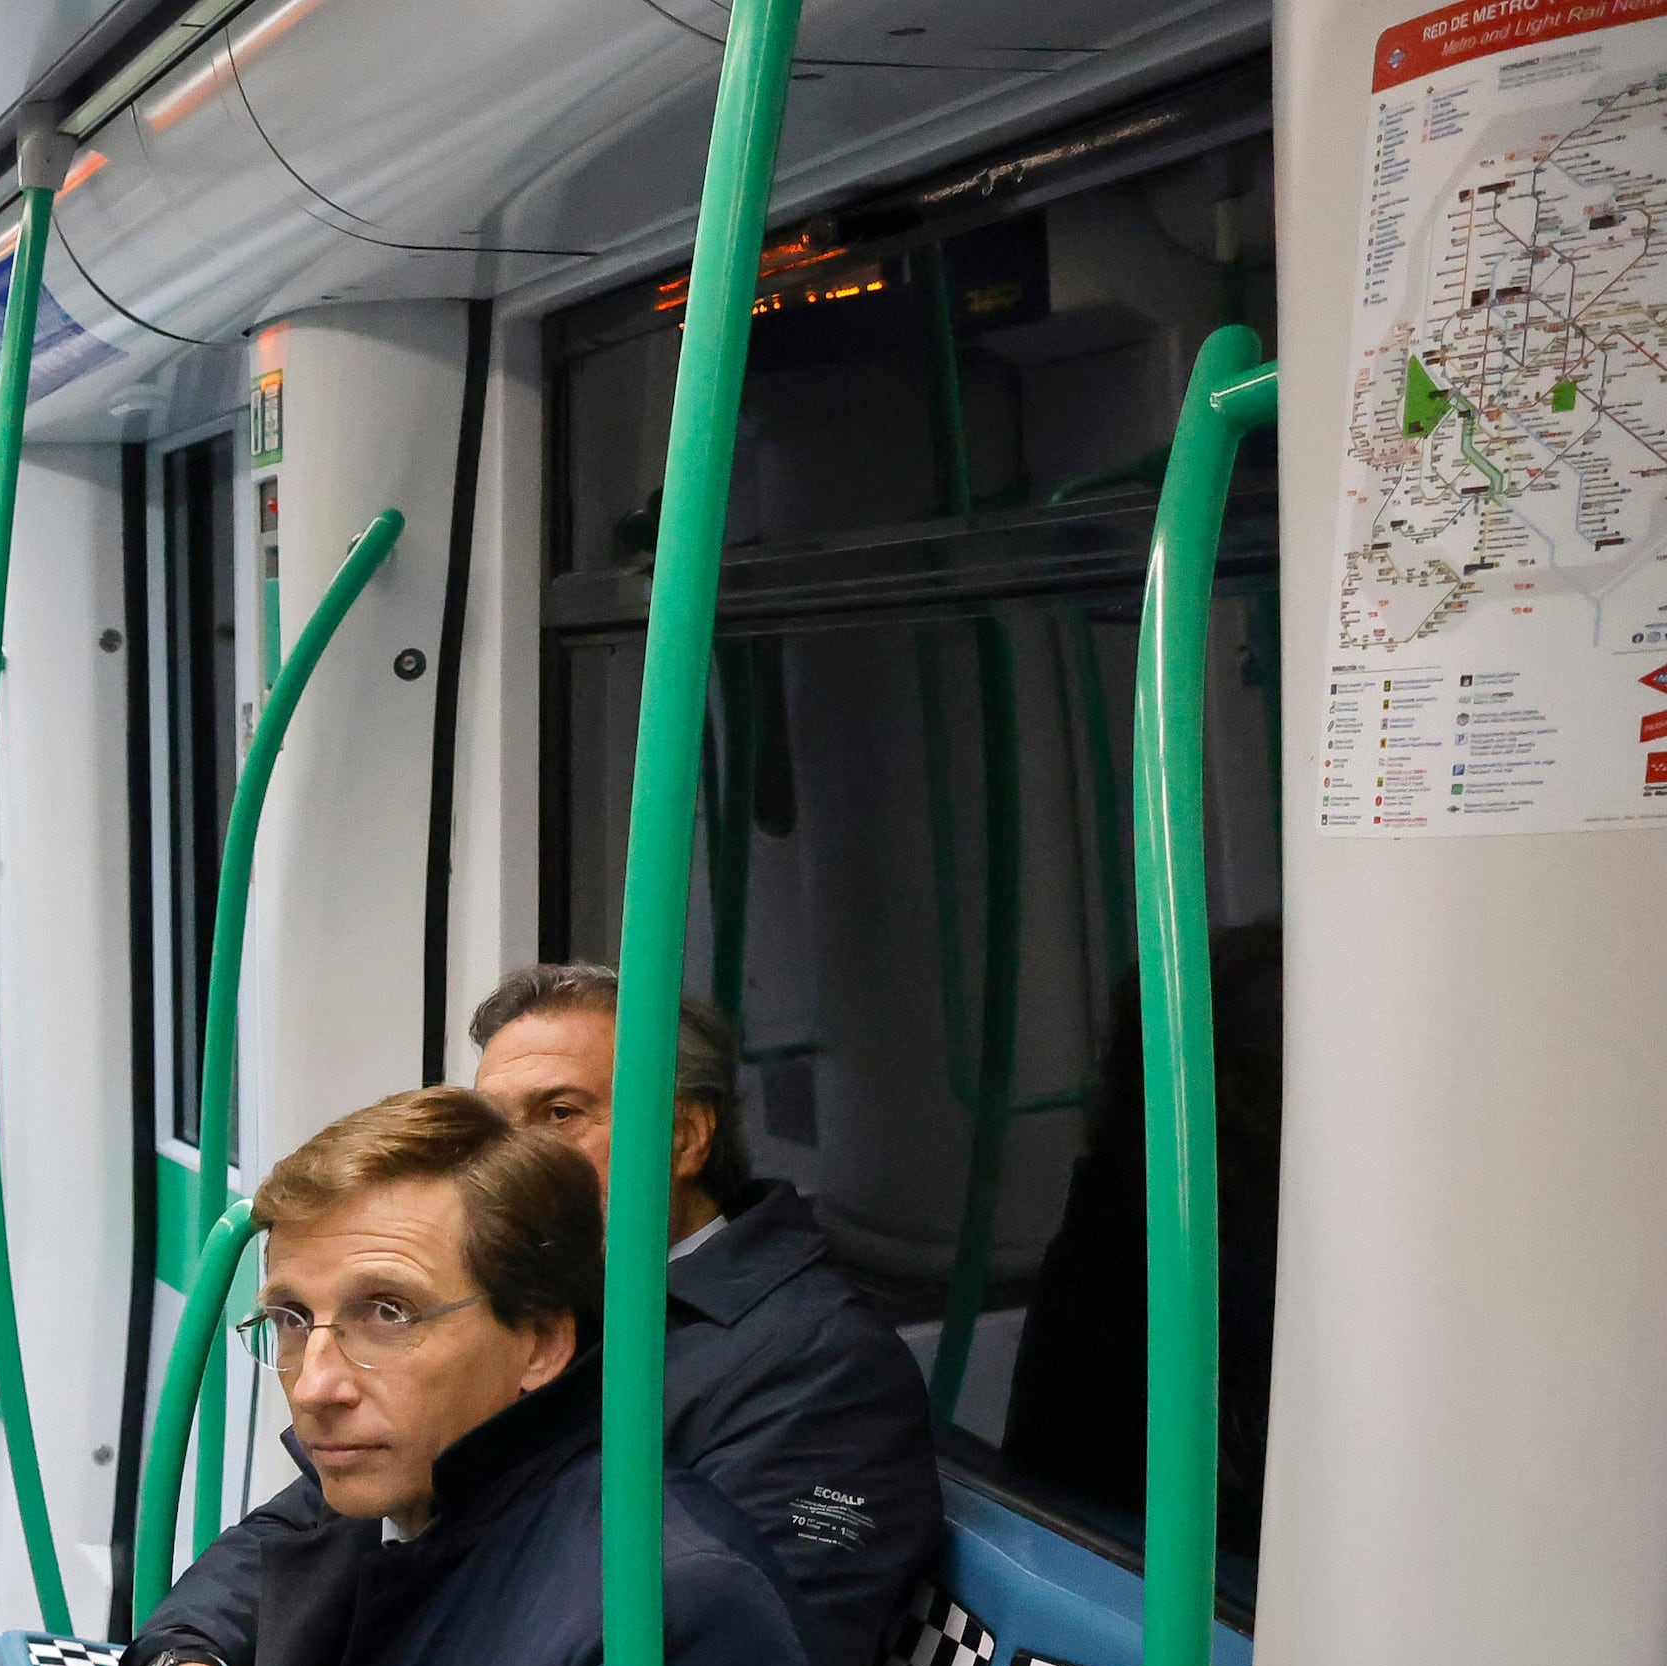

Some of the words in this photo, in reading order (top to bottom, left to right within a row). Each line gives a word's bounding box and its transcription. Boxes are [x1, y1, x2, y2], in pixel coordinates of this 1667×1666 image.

[1422, 21, 1448, 41] RED
[1450, 12, 1469, 31] DE
[1473, 0, 1538, 24] METRO
[1442, 36, 1476, 56] Metro
[1480, 26, 1510, 45] and
[1515, 11, 1562, 37] Light
[792, 1515, 806, 1526] 70
